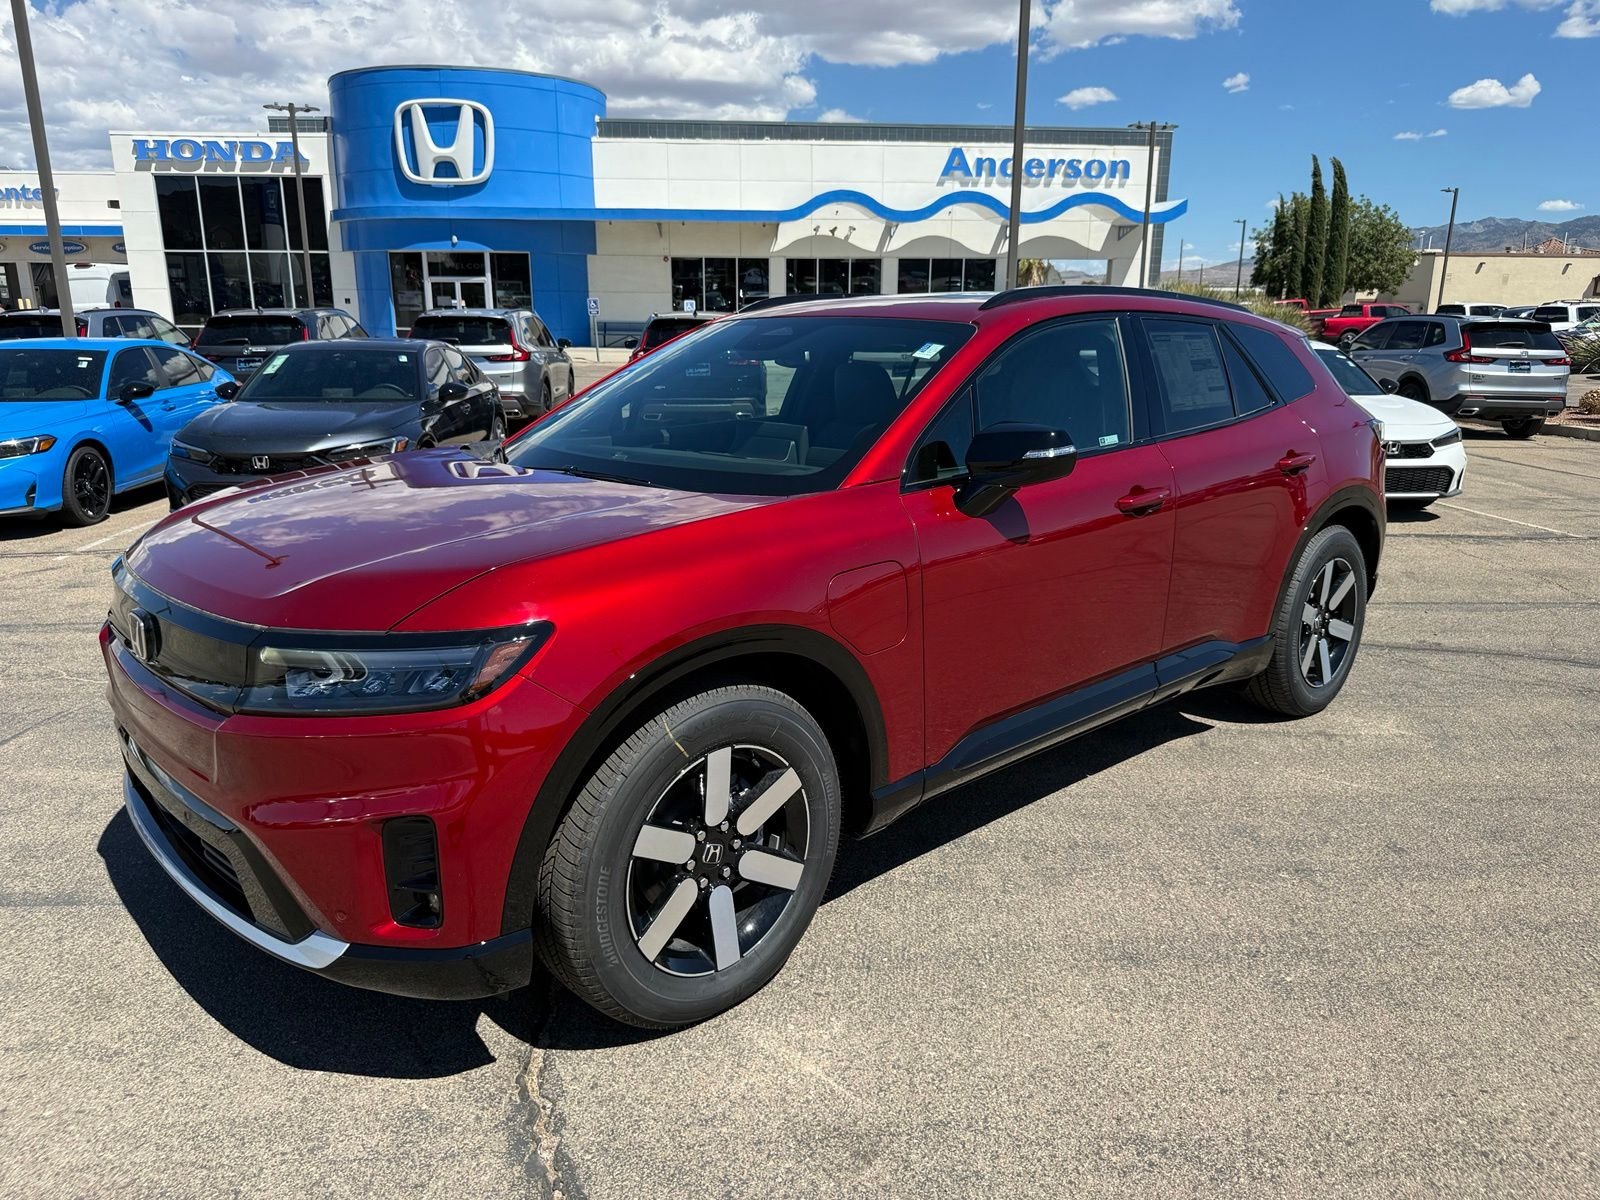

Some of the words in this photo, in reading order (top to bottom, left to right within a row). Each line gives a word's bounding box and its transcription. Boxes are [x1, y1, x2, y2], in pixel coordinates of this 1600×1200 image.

[132, 139, 310, 164] HONDA
[0, 184, 59, 200] nte
[822, 769, 836, 857] BRIDGESTONE
[596, 865, 619, 967] BRIDGESTONE
